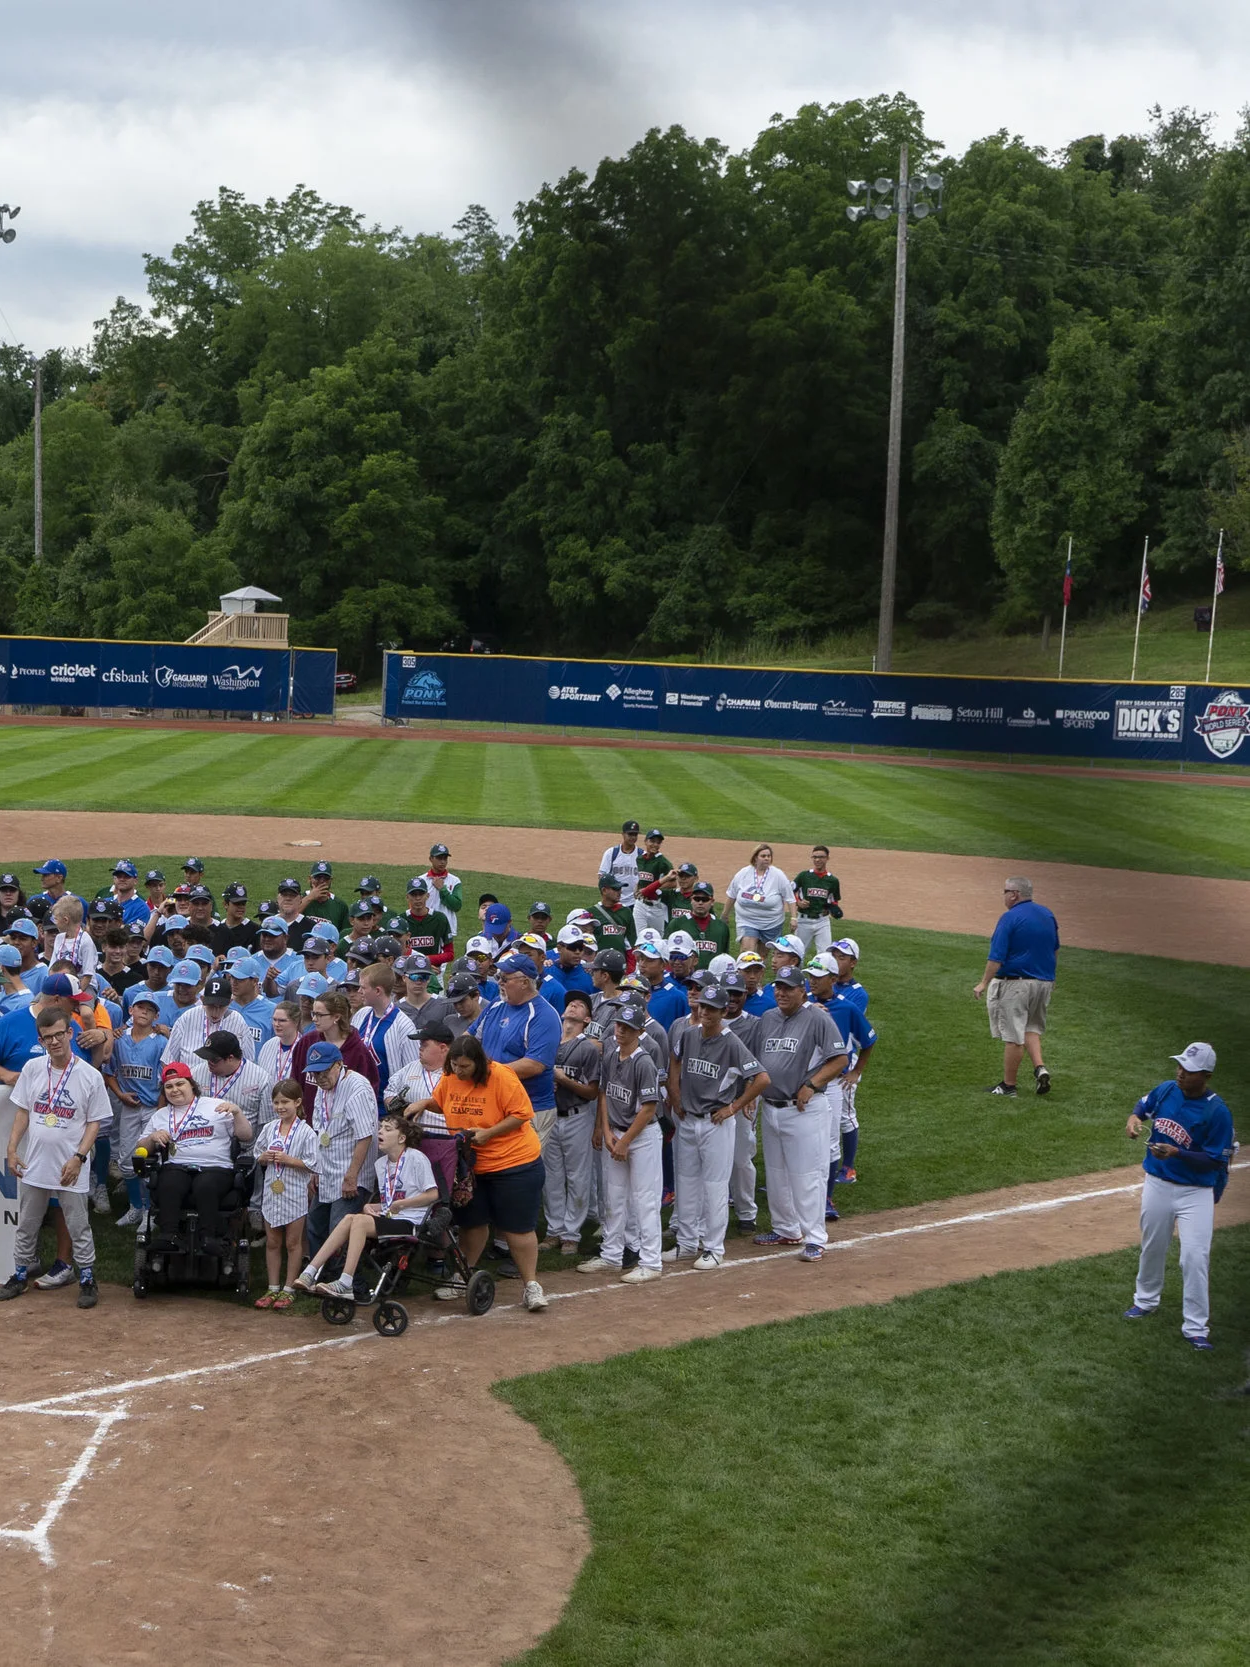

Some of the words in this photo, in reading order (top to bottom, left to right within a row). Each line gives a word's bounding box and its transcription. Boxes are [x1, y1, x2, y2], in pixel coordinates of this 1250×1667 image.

[19, 667, 46, 676] PEOPLES
[50, 663, 97, 677] cricket
[102, 667, 150, 684] cfsbank
[172, 674, 208, 682] GAGLIARDI
[212, 674, 260, 688] Washington
[404, 689, 445, 699] PONY
[561, 686, 579, 694] AT&T
[623, 687, 654, 697] Allegheny
[1170, 687, 1185, 699] 285
[560, 693, 602, 702] SPORTSNET
[726, 698, 761, 707] CHAPMAN
[872, 701, 906, 709] TURFACE
[1207, 705, 1249, 717] PONY
[956, 707, 983, 718] Seton
[985, 707, 1004, 719] Hill
[1064, 710, 1110, 720] PIKEWOOD
[1062, 719, 1095, 729] SPORTS
[1204, 720, 1225, 731] WORLD
[1224, 718, 1246, 728] SERIES
[407, 936, 435, 948] MEXICO
[212, 982, 221, 994] P
[777, 1037, 799, 1053] VALLEY
[695, 1059, 720, 1080] VALLEY
[611, 1083, 632, 1104] VALLEY
[1154, 1117, 1193, 1149] CHINESE
